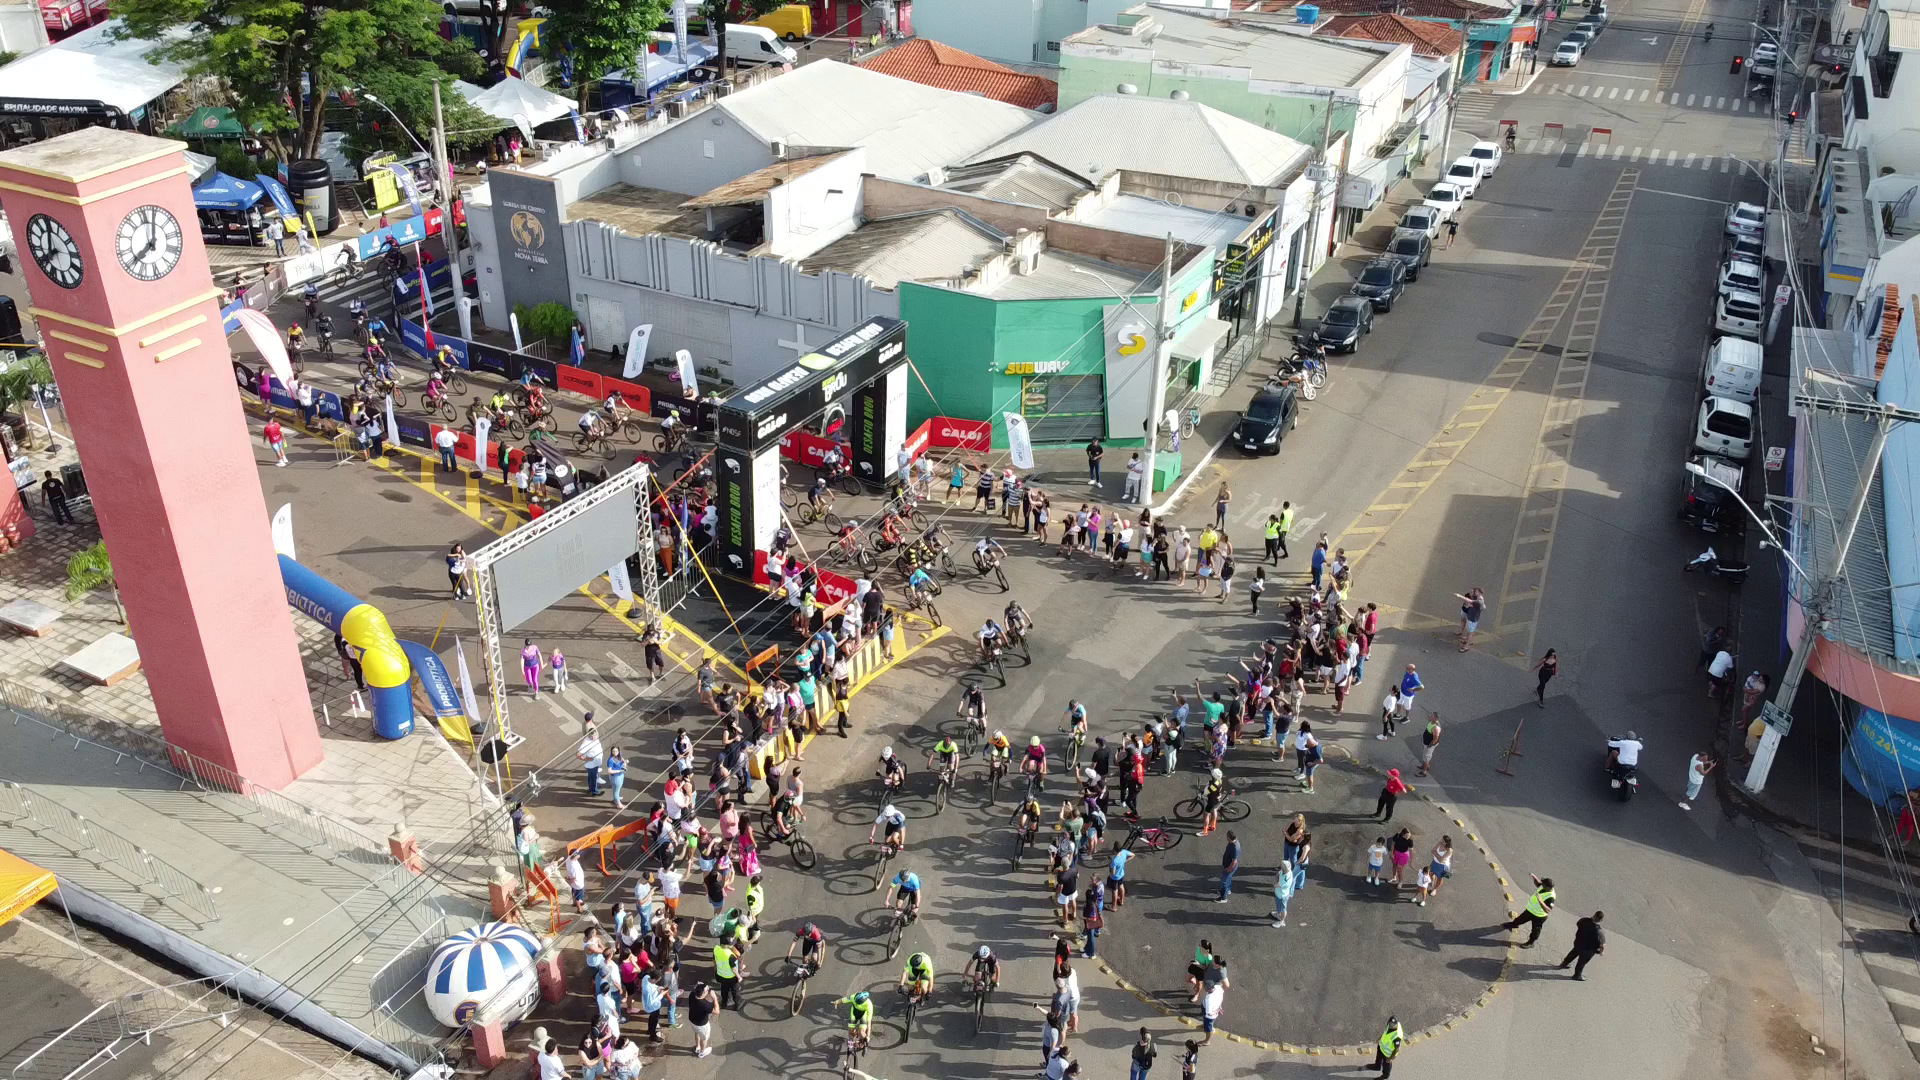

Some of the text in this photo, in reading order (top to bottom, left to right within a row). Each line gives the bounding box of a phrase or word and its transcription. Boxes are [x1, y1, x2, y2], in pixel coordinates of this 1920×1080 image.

[514, 251, 549, 265] NOVA TERRA
[825, 333, 860, 356] DESAFIO
[856, 322, 884, 341] BROU
[878, 341, 903, 364] CALOI
[1004, 360, 1070, 376] SUBWAY
[657, 400, 691, 413] PROBITICA
[757, 412, 788, 439] CALOI
[863, 395, 874, 454] DESAFIO BROU
[941, 427, 983, 441] CALOI
[729, 481, 742, 547] DESAFIO BROU
[284, 586, 333, 627] BIOTICA
[424, 655, 454, 707] PROBIOTICA
